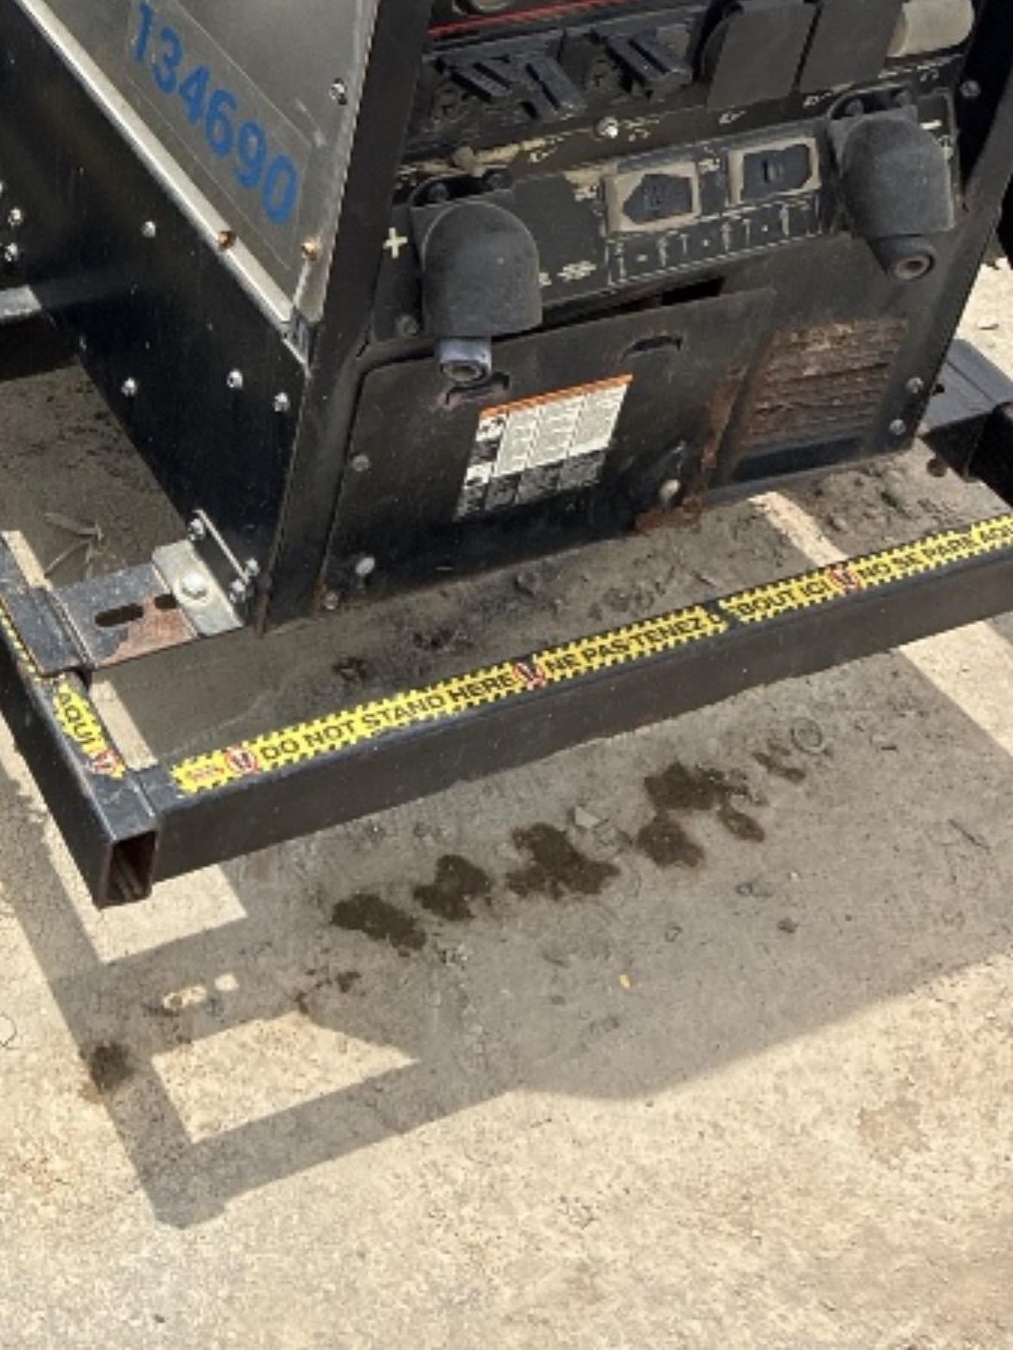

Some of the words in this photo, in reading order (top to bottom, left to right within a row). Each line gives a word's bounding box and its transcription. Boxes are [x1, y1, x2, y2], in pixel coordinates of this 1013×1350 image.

[579, 639, 630, 668] PAS
[630, 616, 704, 648] TENEZ
[735, 588, 794, 617] BOUT
[259, 738, 301, 761] DO
[303, 720, 358, 749] NOT
[360, 693, 448, 730] STAND
[449, 669, 517, 701] HERE
